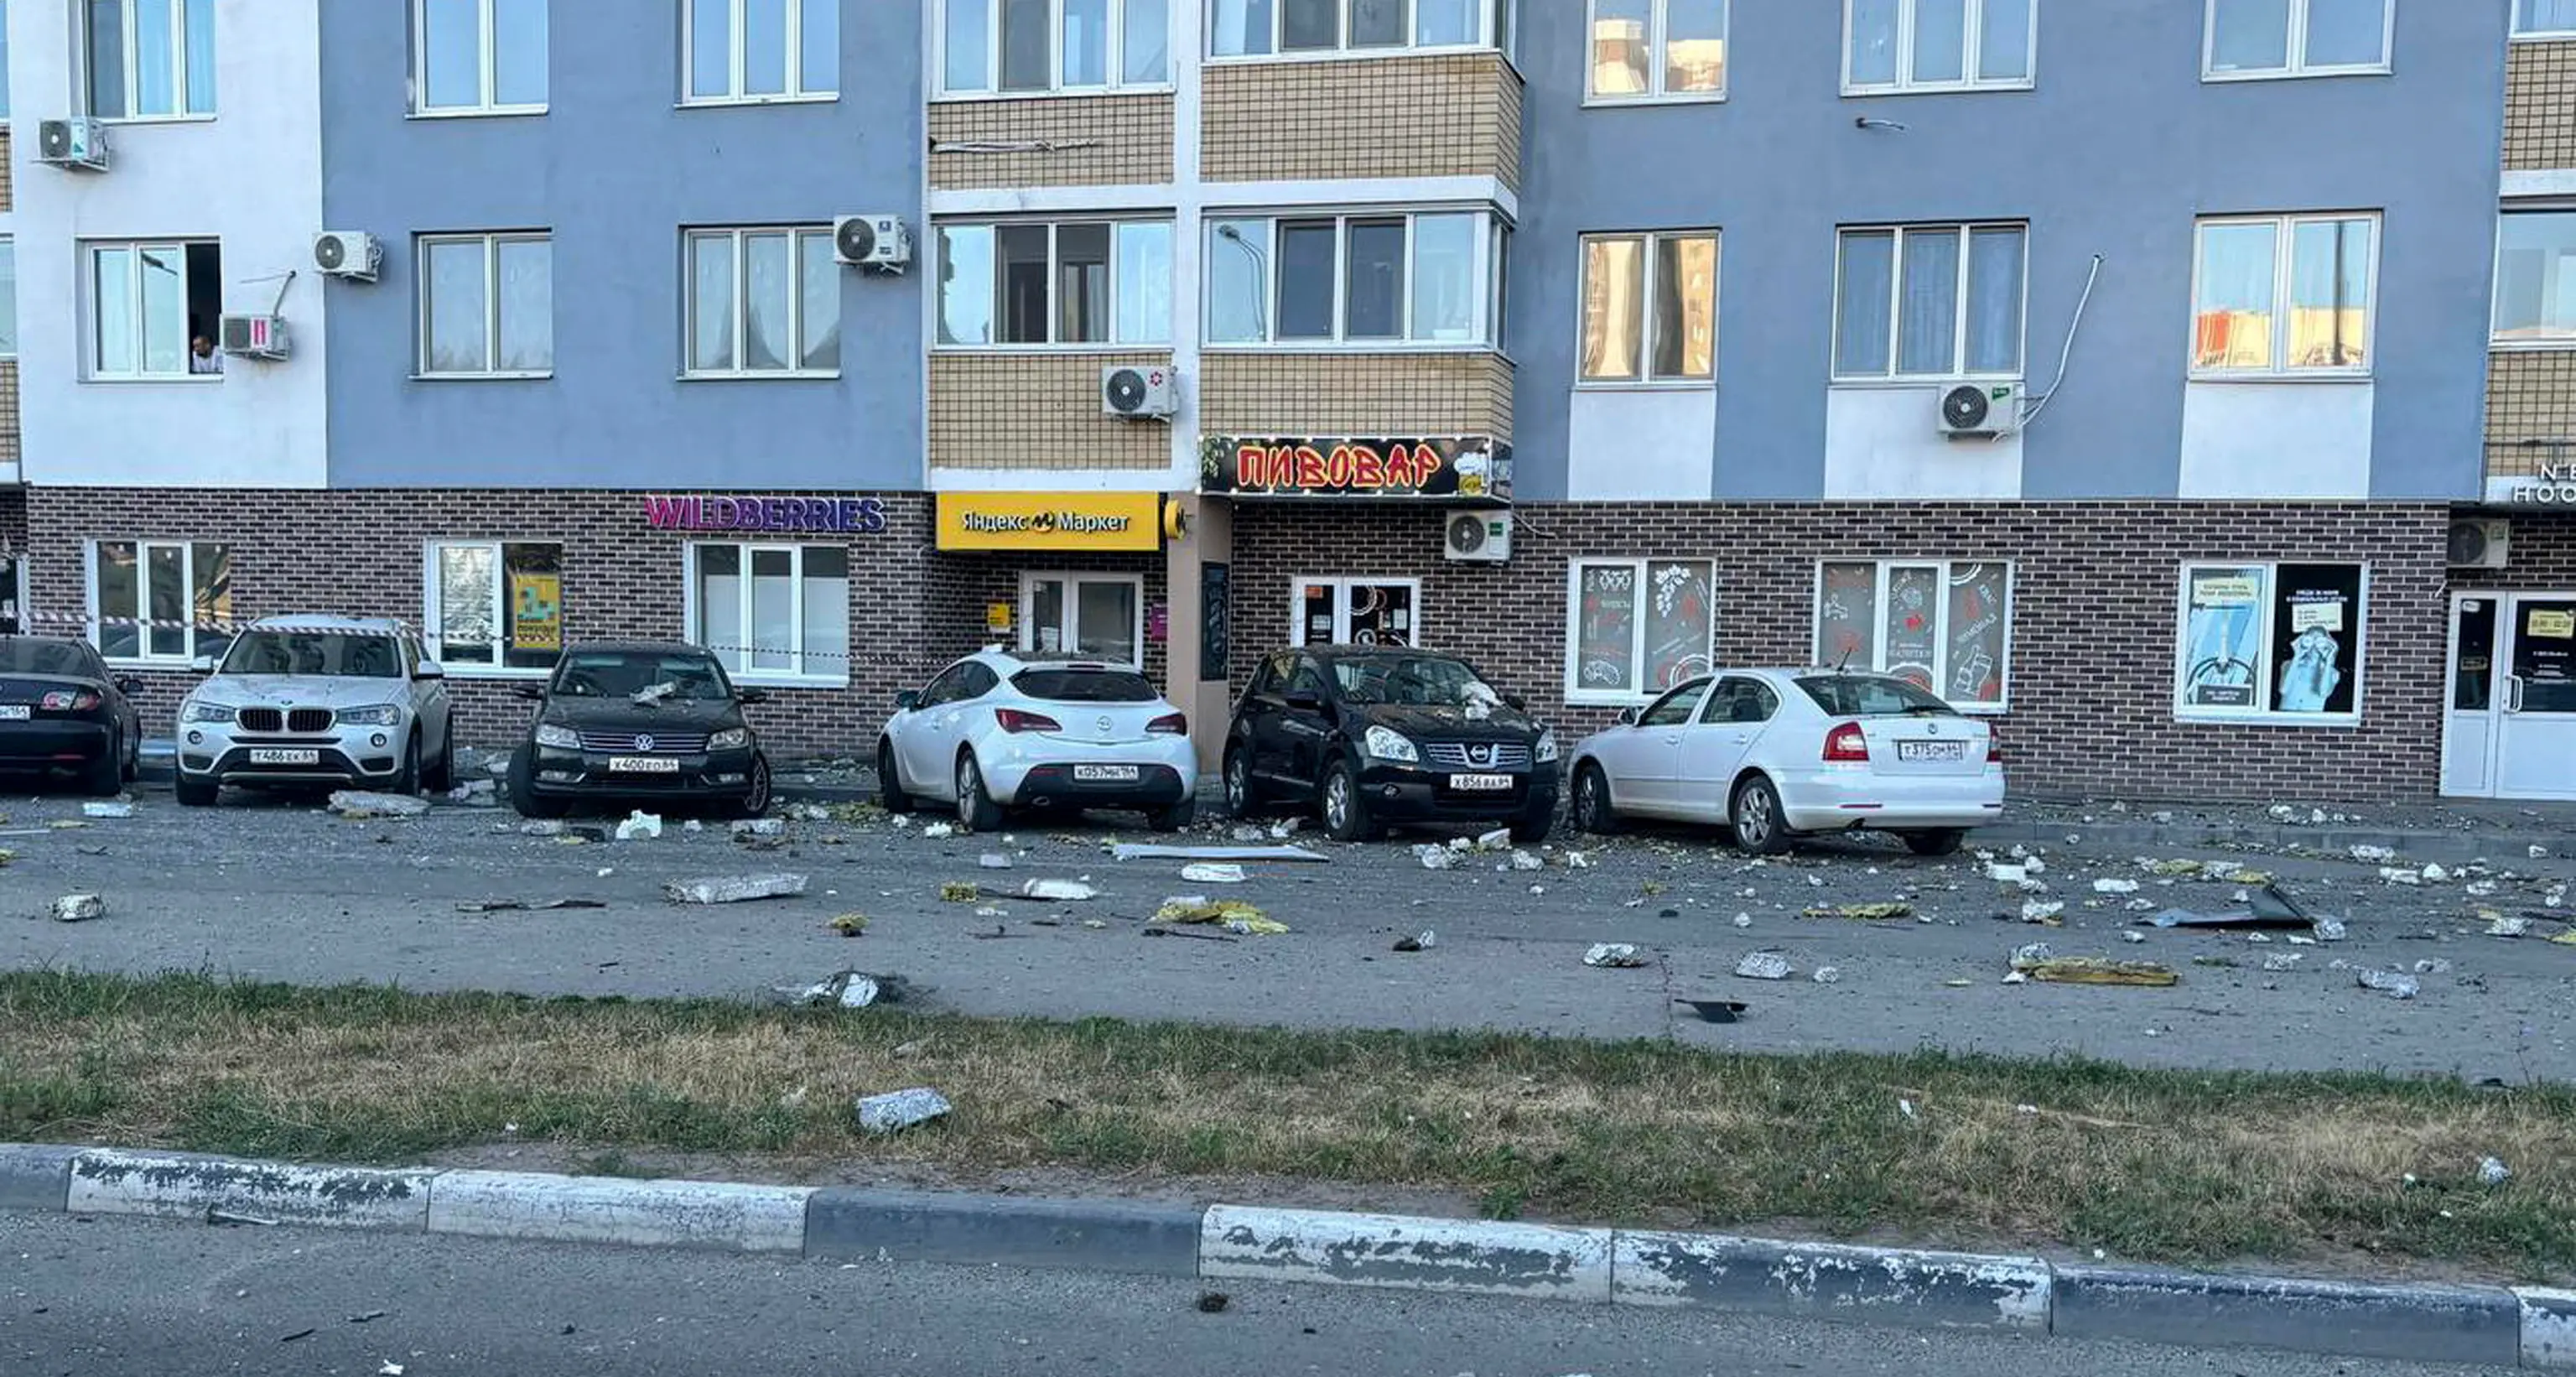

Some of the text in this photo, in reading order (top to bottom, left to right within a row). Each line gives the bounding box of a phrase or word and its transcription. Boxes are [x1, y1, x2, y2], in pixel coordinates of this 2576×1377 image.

[1237, 444, 1441, 489] ПИВОВАР
[643, 495, 886, 532] WILDBERRIES
[961, 511, 1130, 533] Яндекс Маркет
